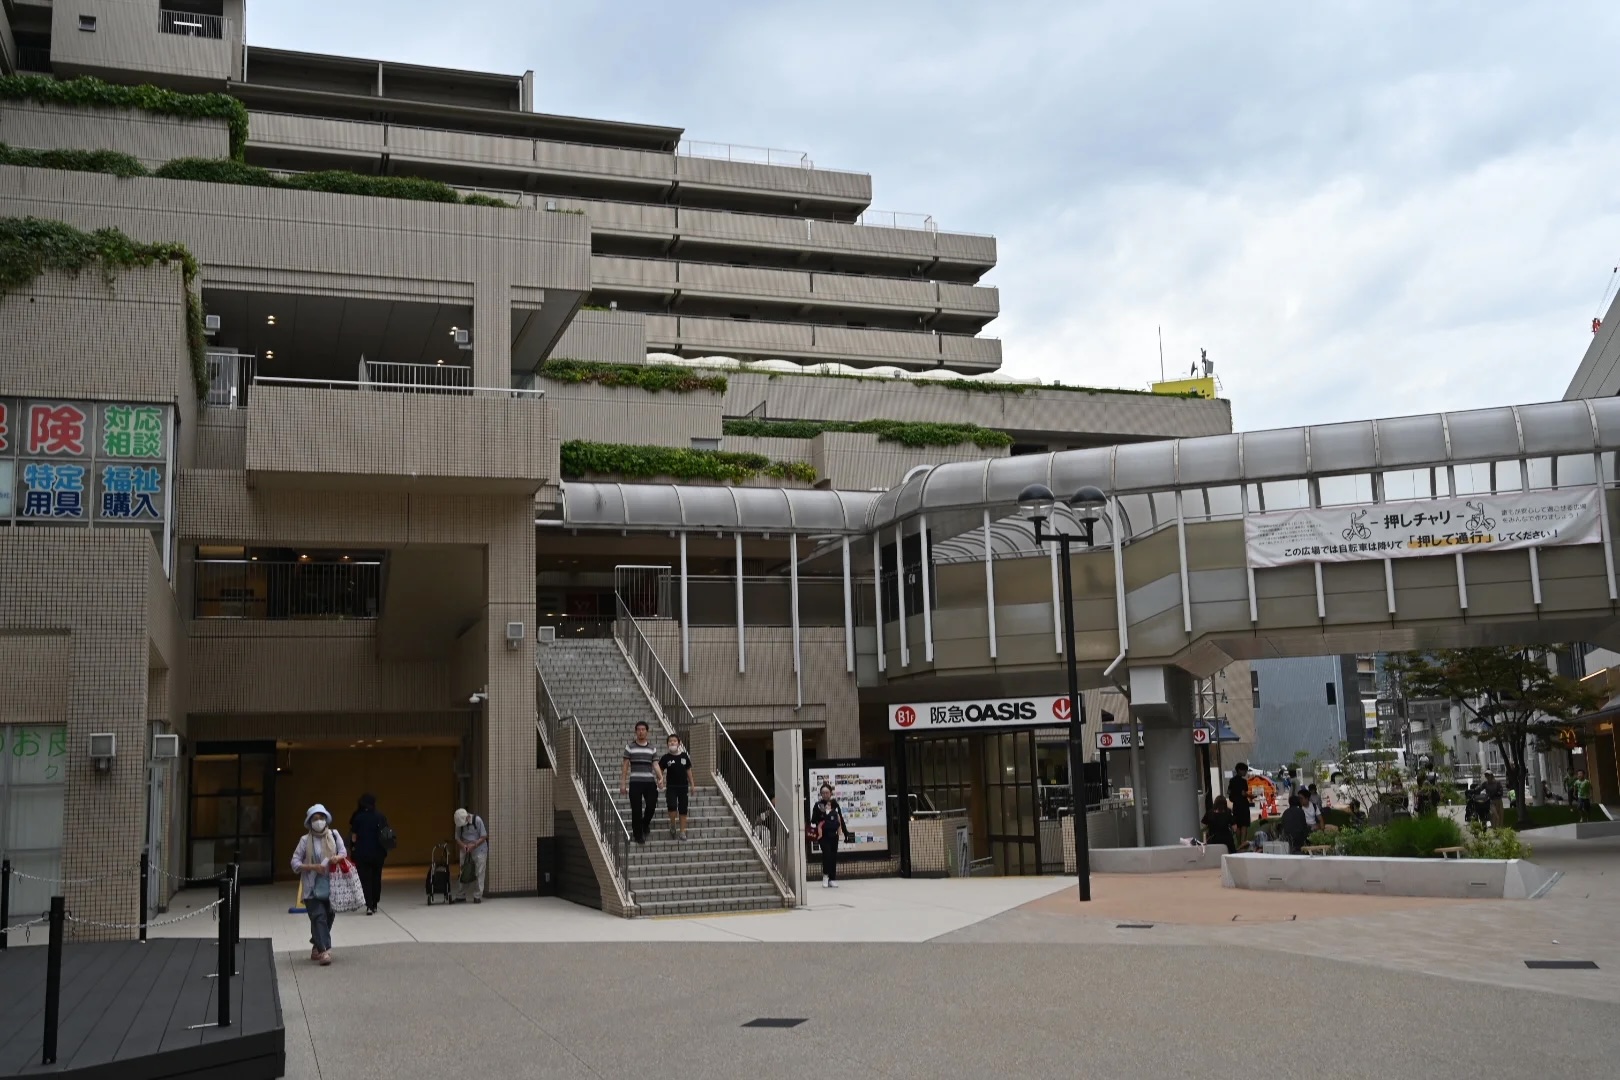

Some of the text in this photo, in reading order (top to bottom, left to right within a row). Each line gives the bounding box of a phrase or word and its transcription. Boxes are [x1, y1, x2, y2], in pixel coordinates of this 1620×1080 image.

[0, 404, 85, 453] 険
[105, 406, 161, 431] 対応
[104, 432, 161, 457] 相談
